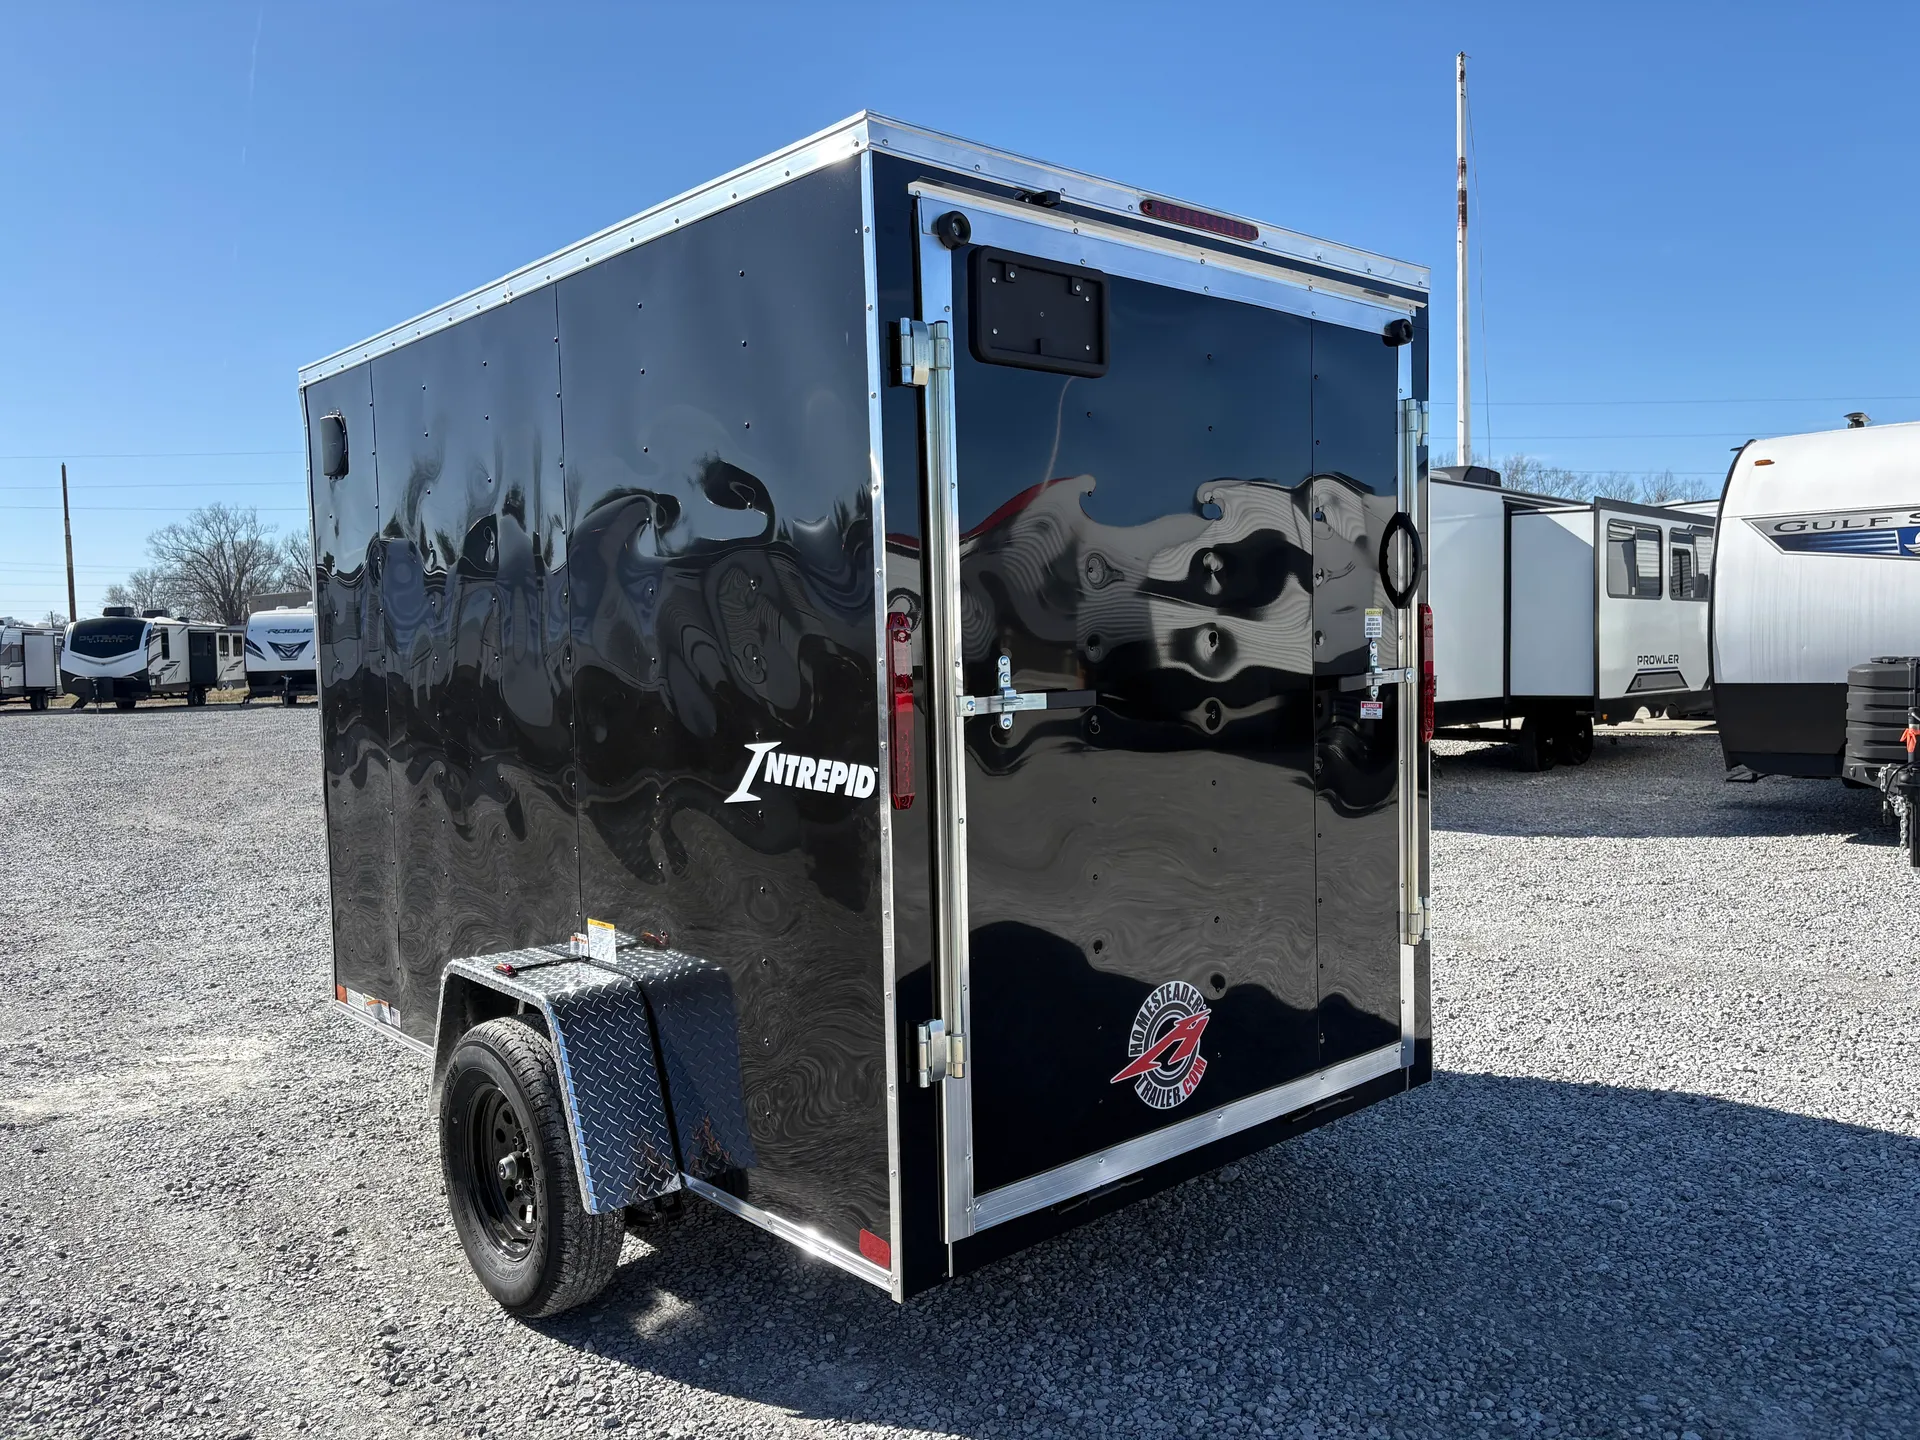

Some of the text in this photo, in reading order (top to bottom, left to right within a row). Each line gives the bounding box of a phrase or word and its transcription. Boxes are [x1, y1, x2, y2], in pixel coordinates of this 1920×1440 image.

[1773, 516, 1893, 533] GULF
[79, 634, 134, 642] OUTBACK
[1637, 654, 1680, 666] PROWLER
[724, 741, 876, 803] INTREPID
[1129, 982, 1203, 1057] HOMESTEADER
[1136, 1059, 1207, 1108] TRAILER.COM
